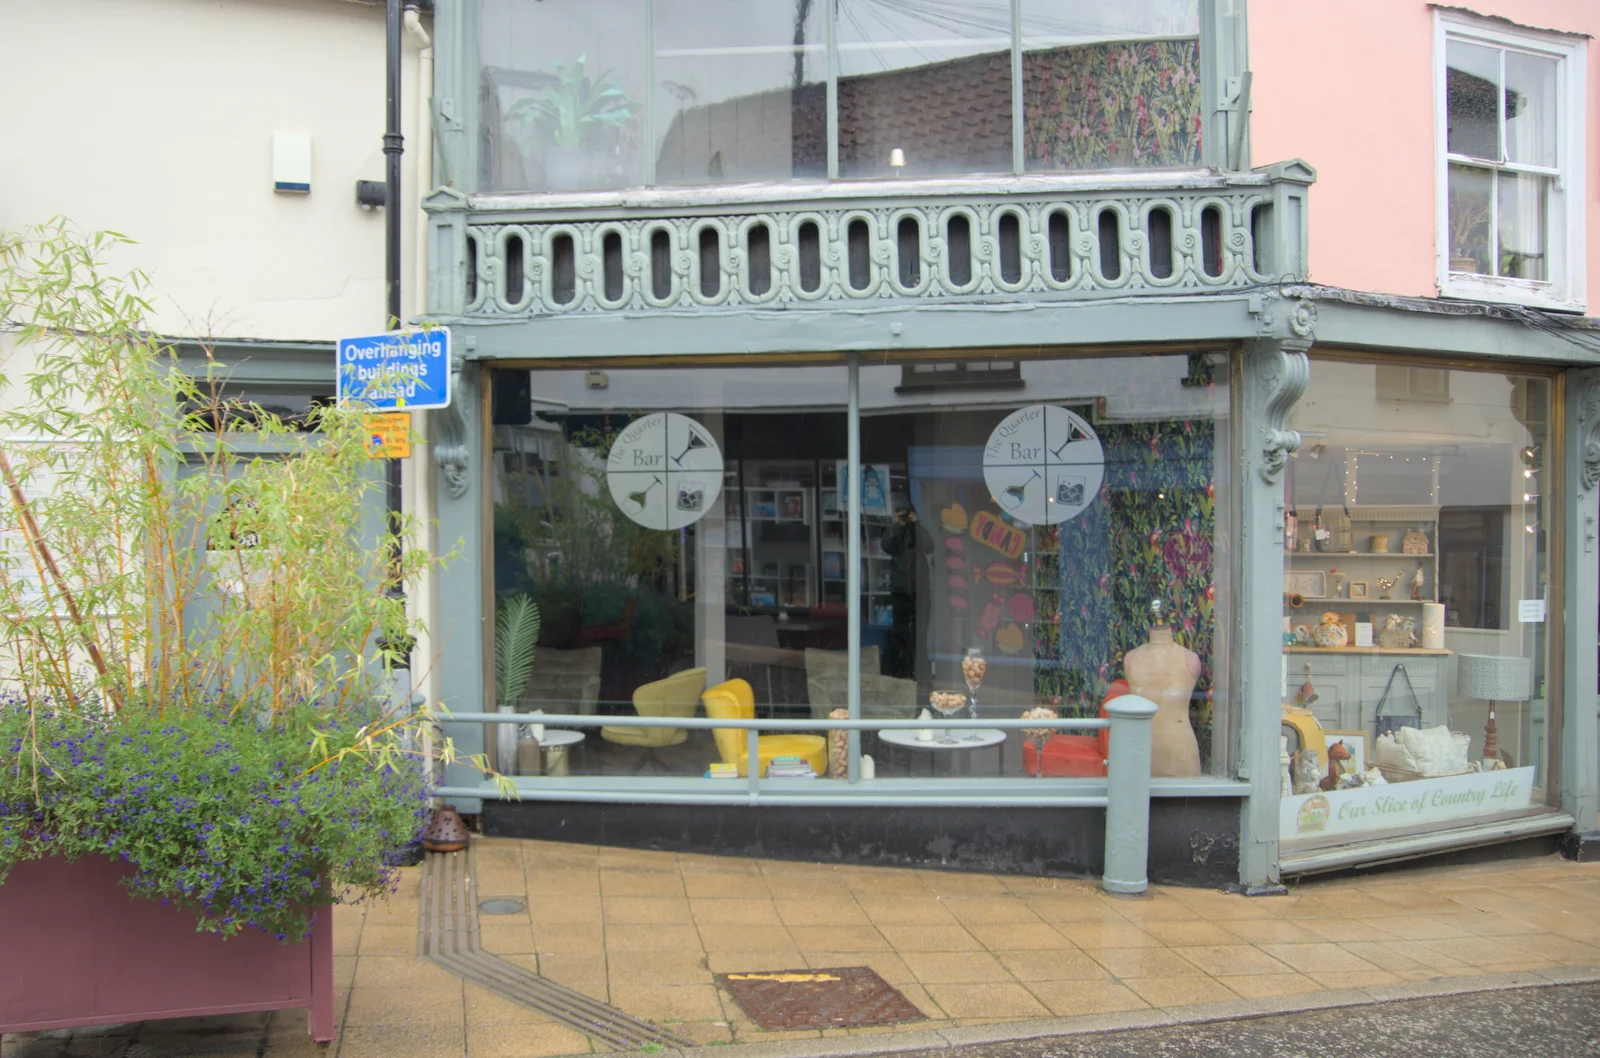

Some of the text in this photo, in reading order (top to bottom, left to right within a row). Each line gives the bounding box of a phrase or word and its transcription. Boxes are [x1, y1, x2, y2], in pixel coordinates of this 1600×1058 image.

[345, 339, 442, 361] Overhanging
[610, 418, 662, 465] The Quarter
[986, 409, 1041, 460] The Quarter
[633, 449, 663, 466] Bar
[1010, 442, 1041, 460] Bar
[1337, 780, 1519, 820] Our Slice of Country Life
